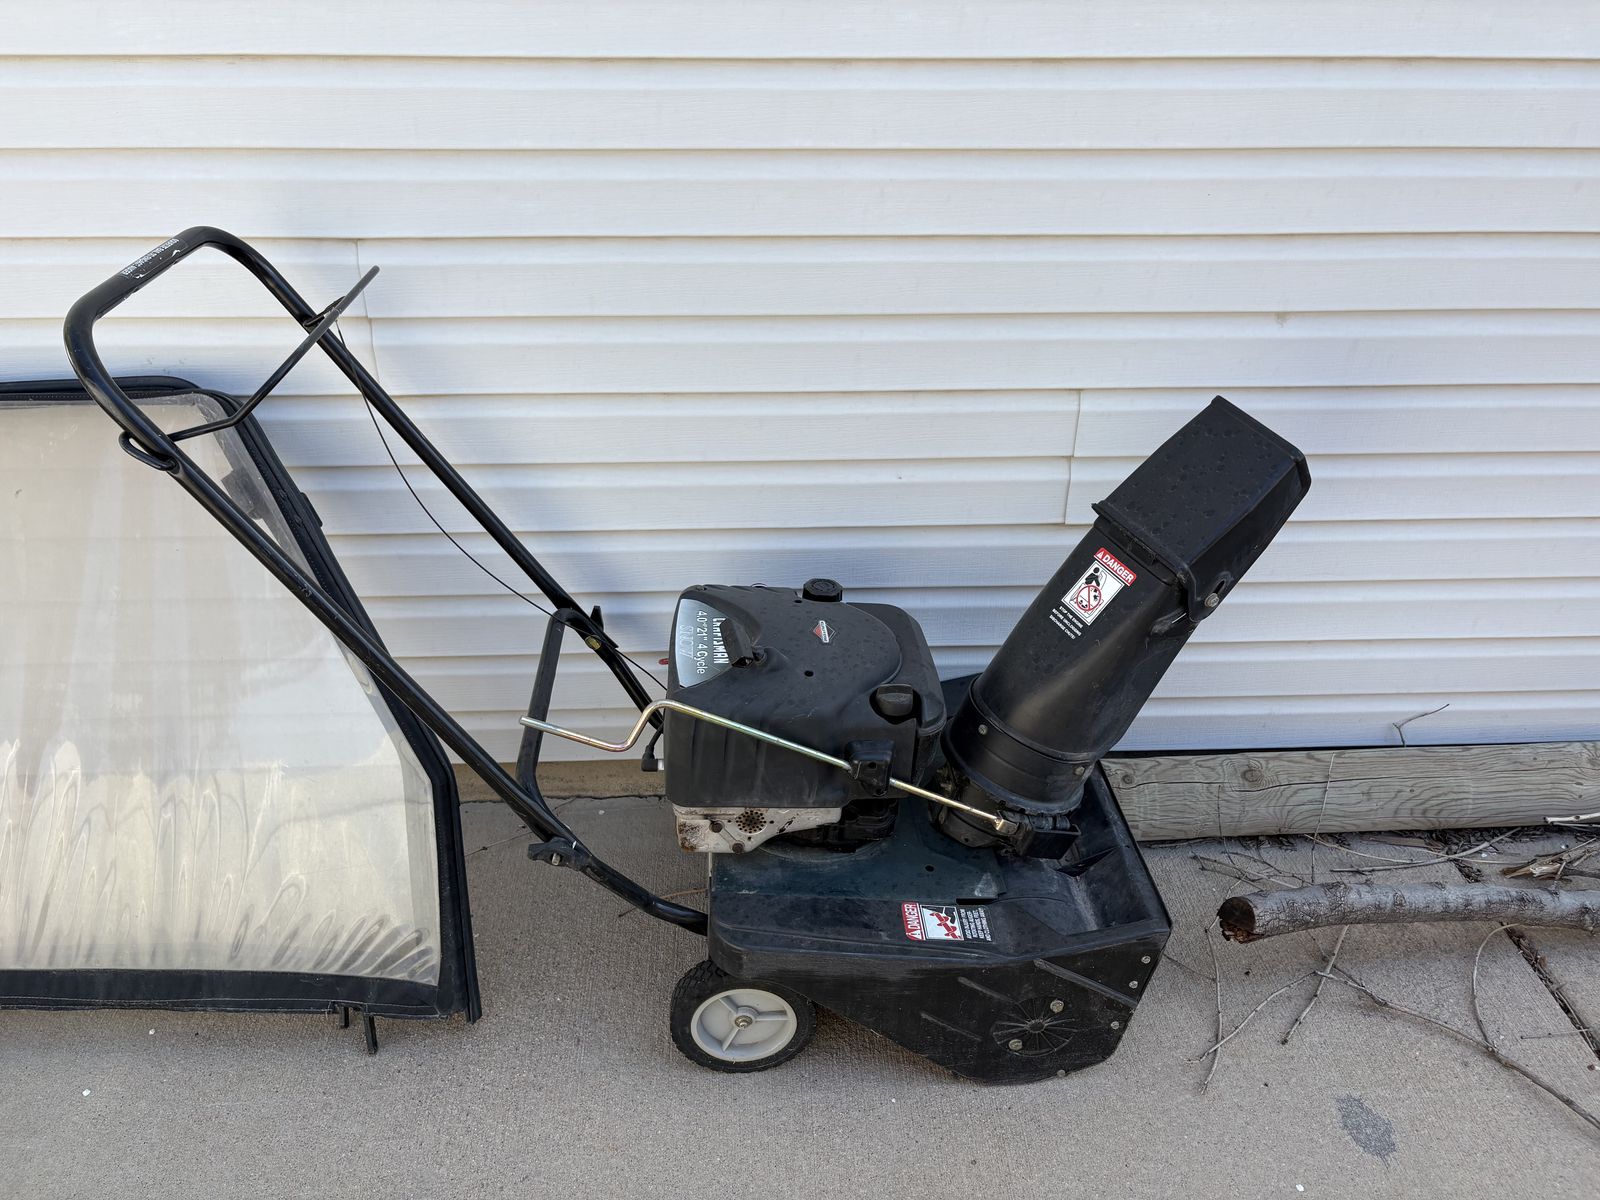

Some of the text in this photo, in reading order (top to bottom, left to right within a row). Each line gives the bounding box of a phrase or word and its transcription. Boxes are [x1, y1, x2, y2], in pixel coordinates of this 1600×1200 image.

[1102, 554, 1134, 582] DANGER
[694, 650, 708, 674] Cycle
[904, 903, 920, 931] DANGER
